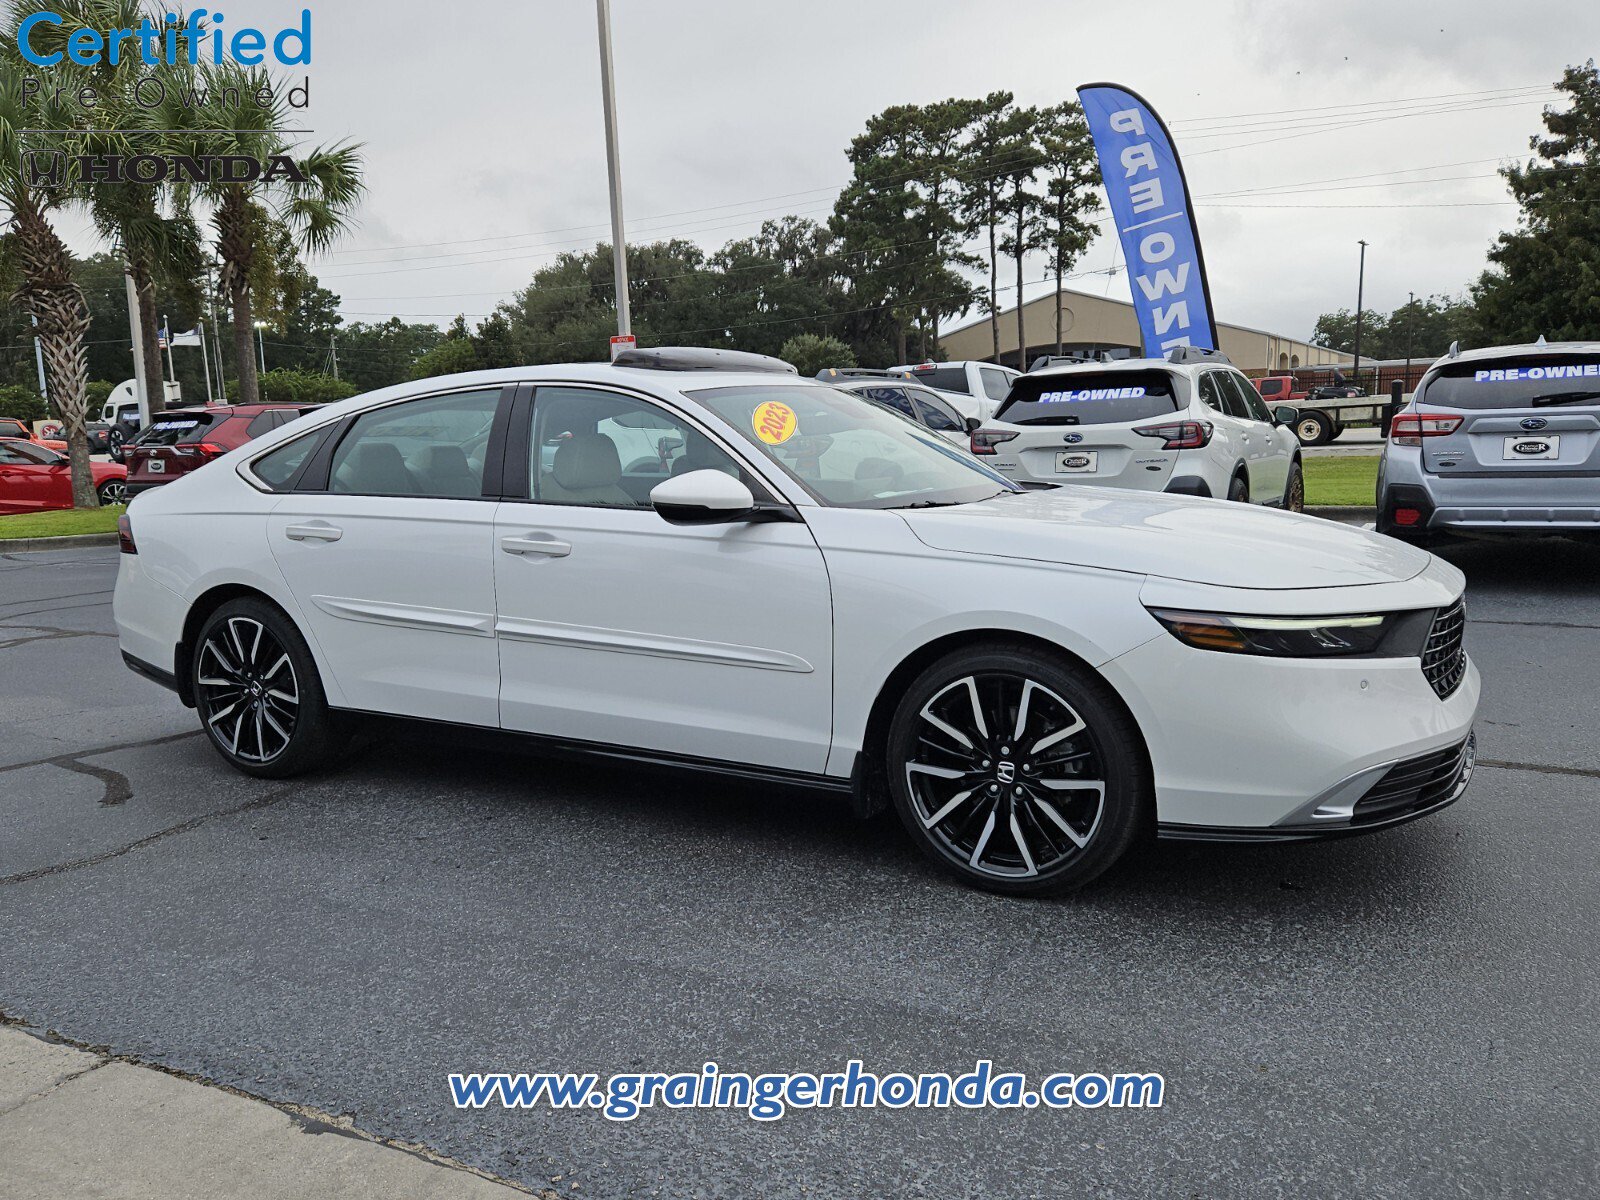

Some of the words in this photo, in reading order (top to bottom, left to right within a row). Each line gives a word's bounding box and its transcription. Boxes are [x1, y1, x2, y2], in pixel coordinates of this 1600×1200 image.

[1474, 364, 1600, 382] PRE-OWNE
[1038, 386, 1146, 404] PRE-OWNED
[759, 402, 790, 440] 2023
